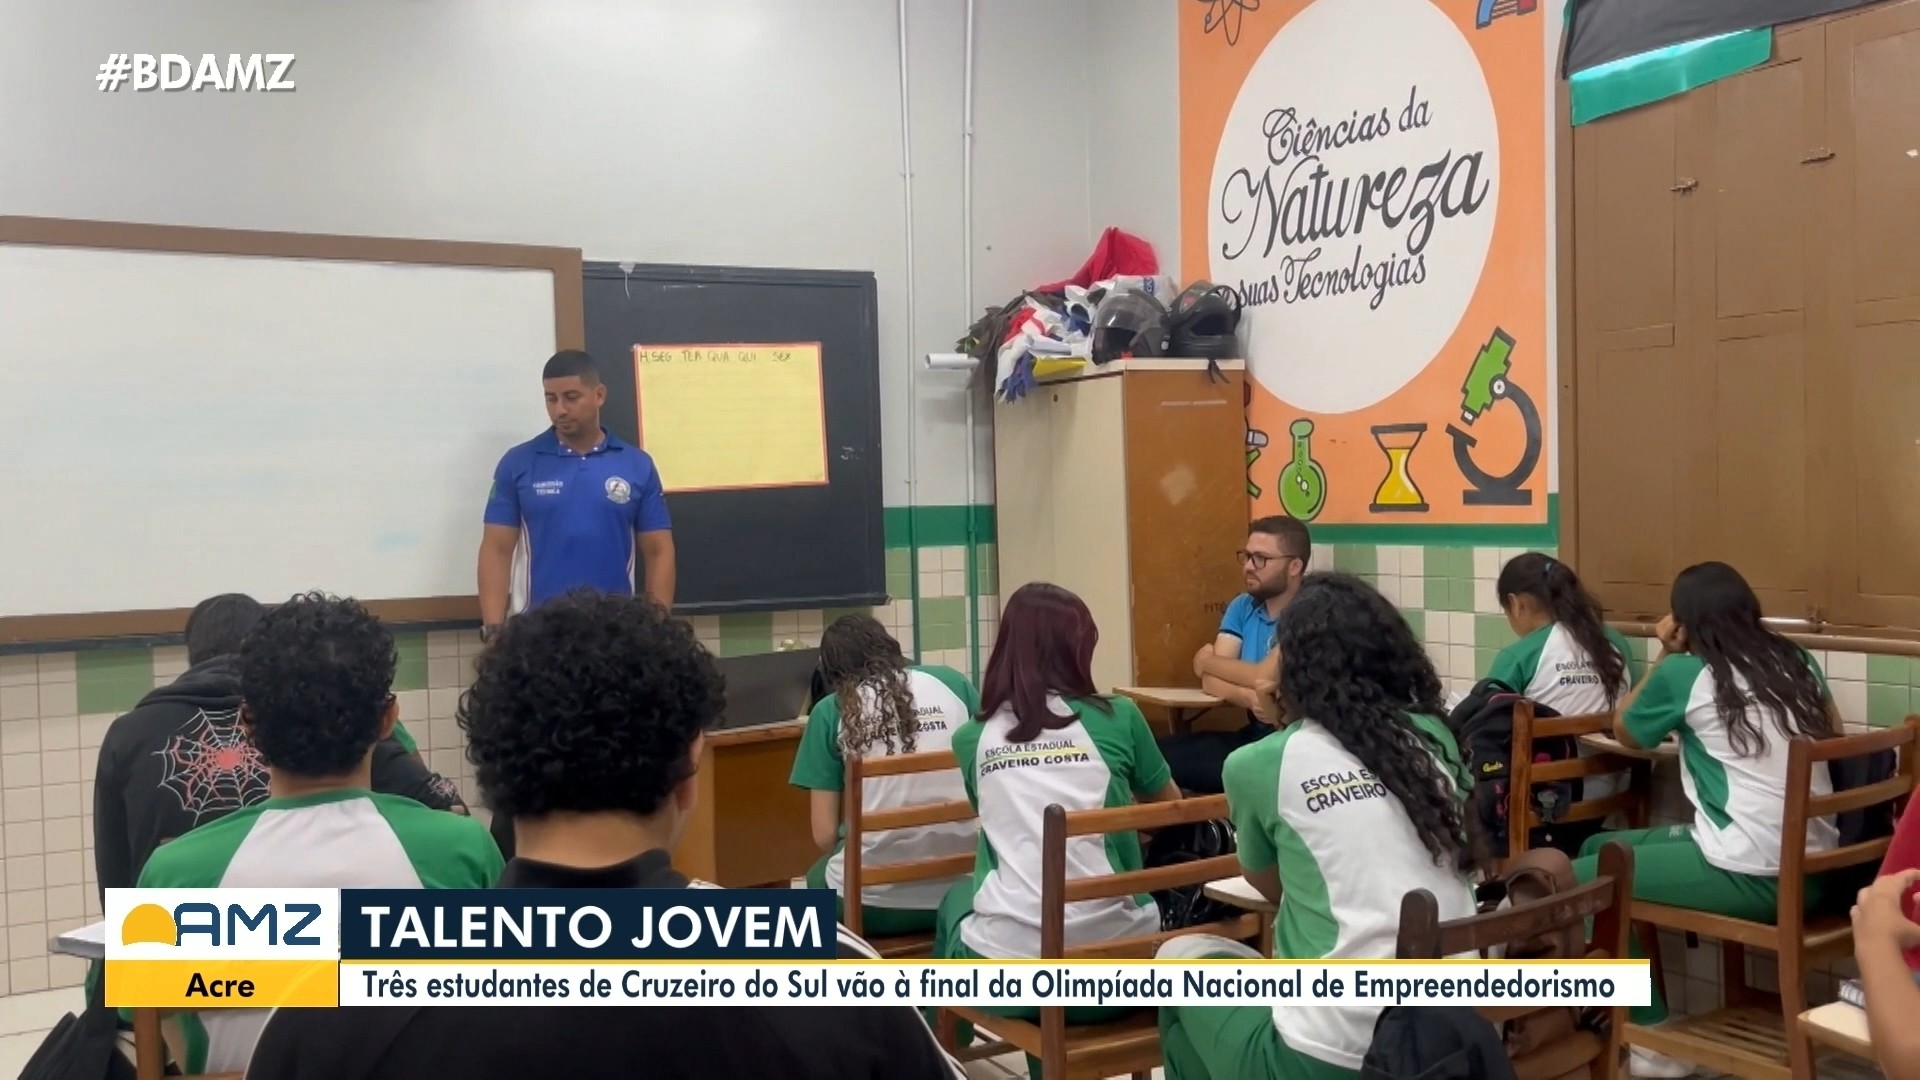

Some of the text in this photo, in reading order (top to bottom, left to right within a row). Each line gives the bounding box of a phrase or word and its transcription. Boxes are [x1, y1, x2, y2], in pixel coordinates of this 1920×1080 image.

[1262, 85, 1434, 165] Ciências da
[1221, 149, 1490, 260] Natureza
[1238, 246, 1427, 310] suas Tecnologias
[980, 752, 1090, 776] CRAVEIRO COSTA
[984, 739, 1076, 759] ESCOLA ESTADUAL
[1300, 770, 1359, 794] ESCOLA
[1305, 783, 1387, 814] CRAVEIRO
